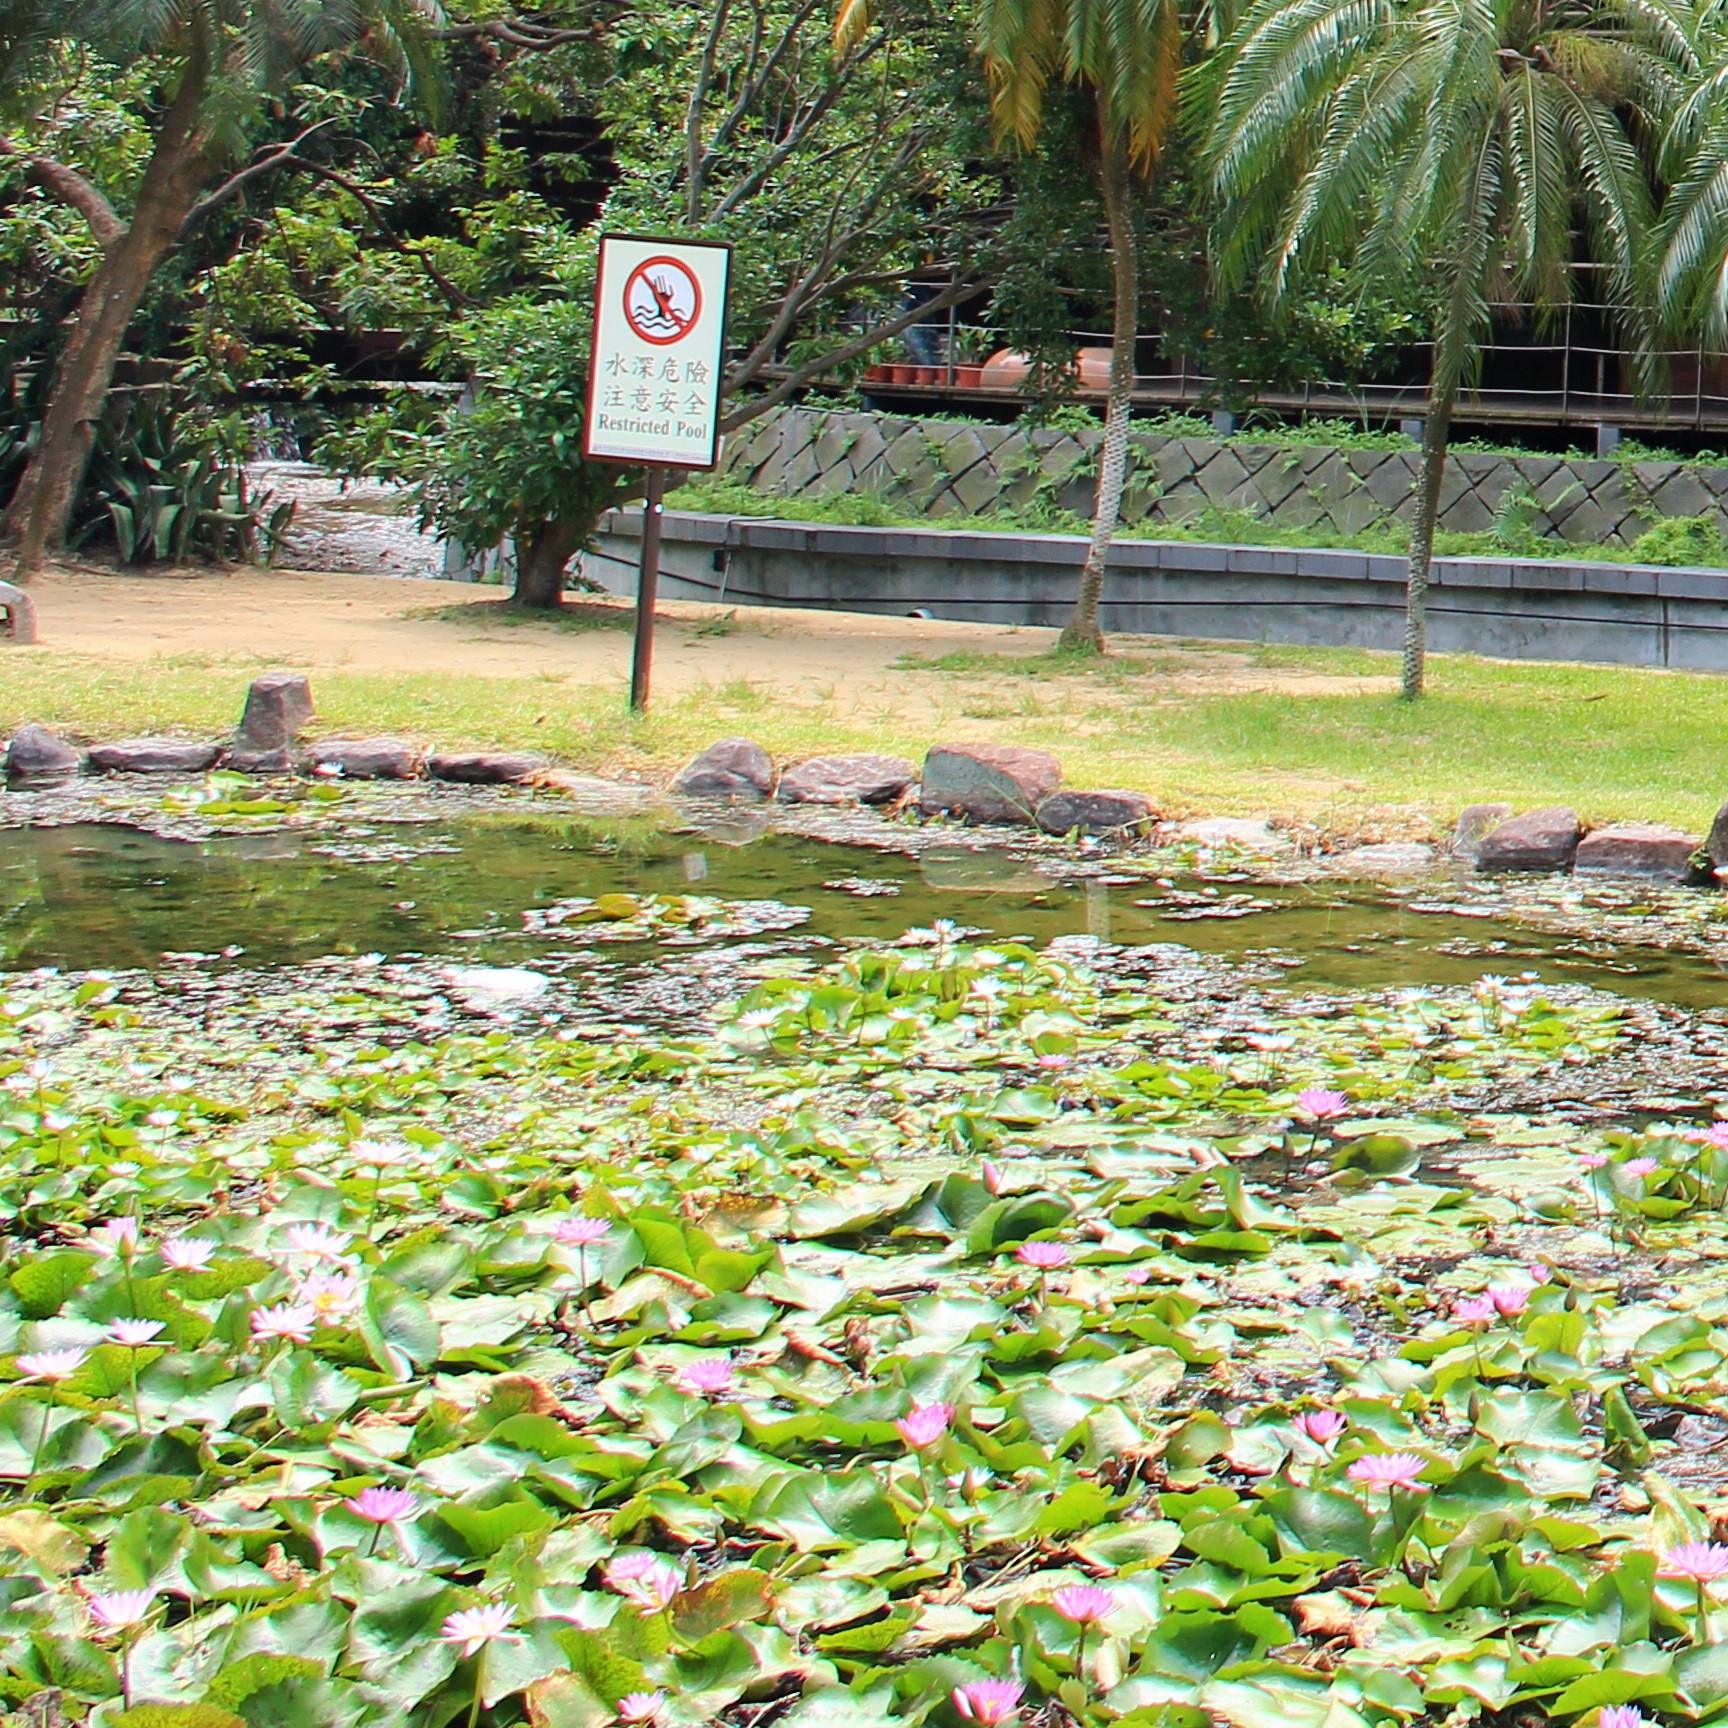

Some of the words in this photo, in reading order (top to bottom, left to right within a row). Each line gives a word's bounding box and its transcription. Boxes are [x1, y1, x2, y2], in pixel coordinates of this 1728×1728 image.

[605, 351, 710, 385] 水深危險
[603, 384, 707, 416] 注意安全
[598, 412, 670, 436] Restricted
[676, 420, 708, 439] Pool
